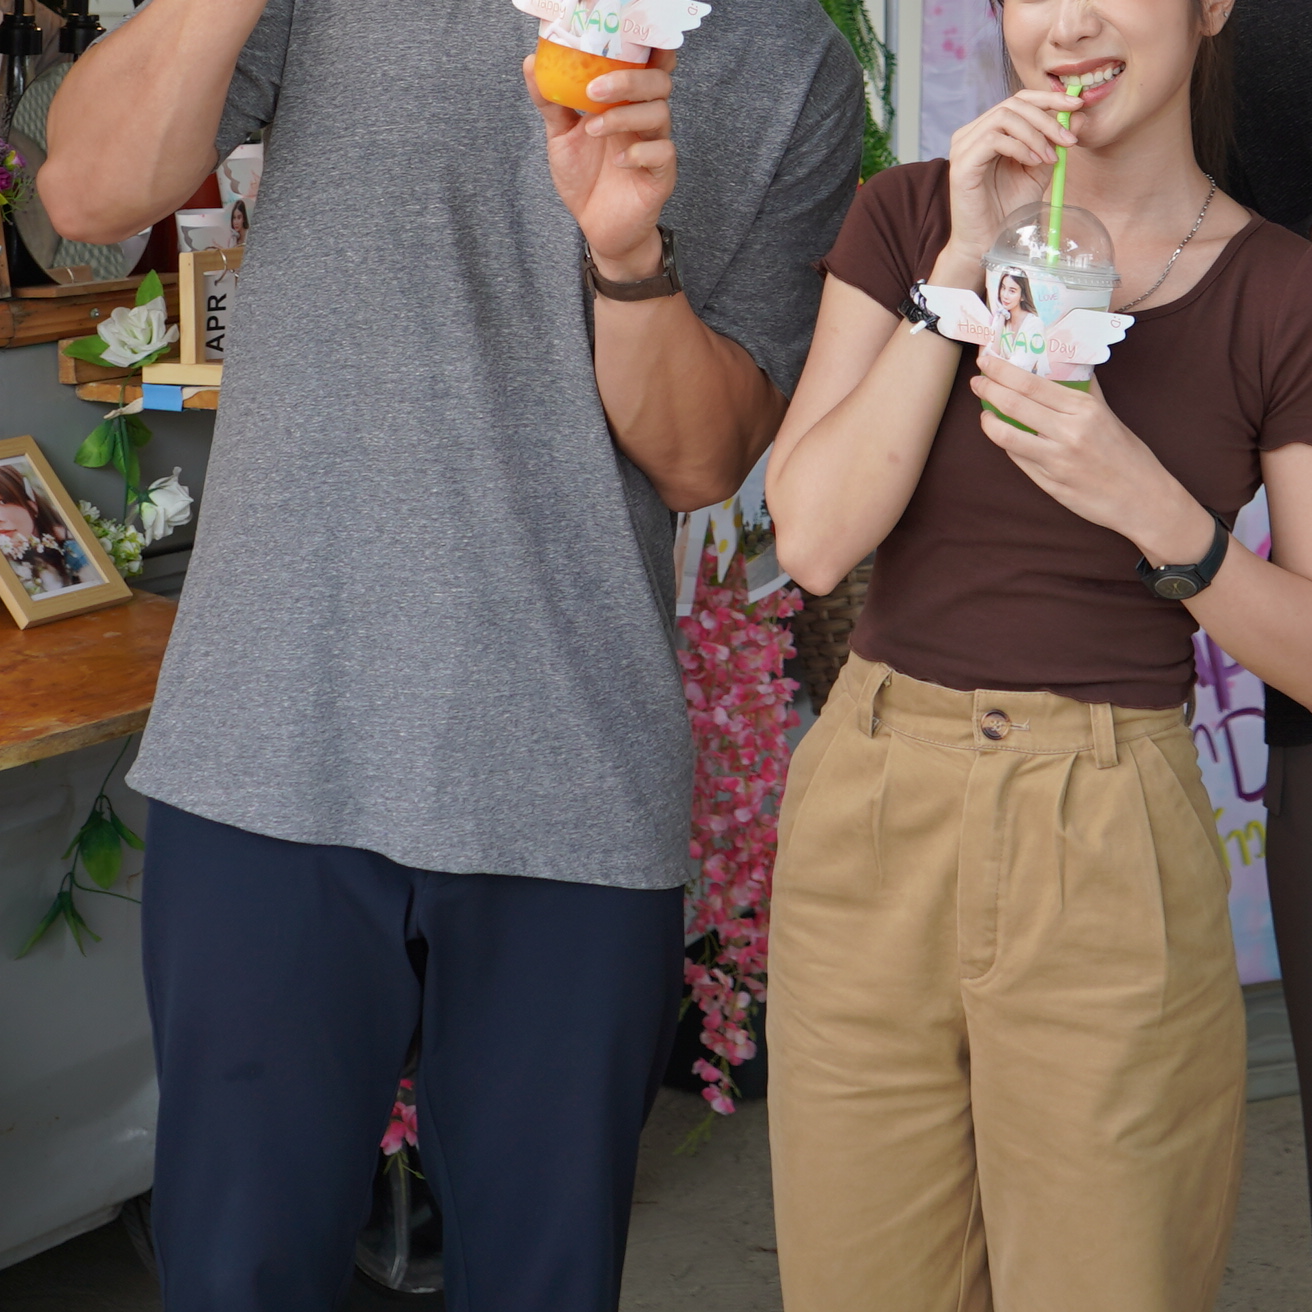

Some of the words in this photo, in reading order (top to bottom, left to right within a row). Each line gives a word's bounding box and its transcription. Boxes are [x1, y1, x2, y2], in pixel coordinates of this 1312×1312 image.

[570, 5, 620, 34] KAO
[623, 18, 650, 42] Day
[1039, 293, 1058, 302] LOVE
[206, 292, 227, 352] APR
[958, 319, 996, 343] Happy
[999, 328, 1046, 355] KAO
[1049, 338, 1077, 359] Day
